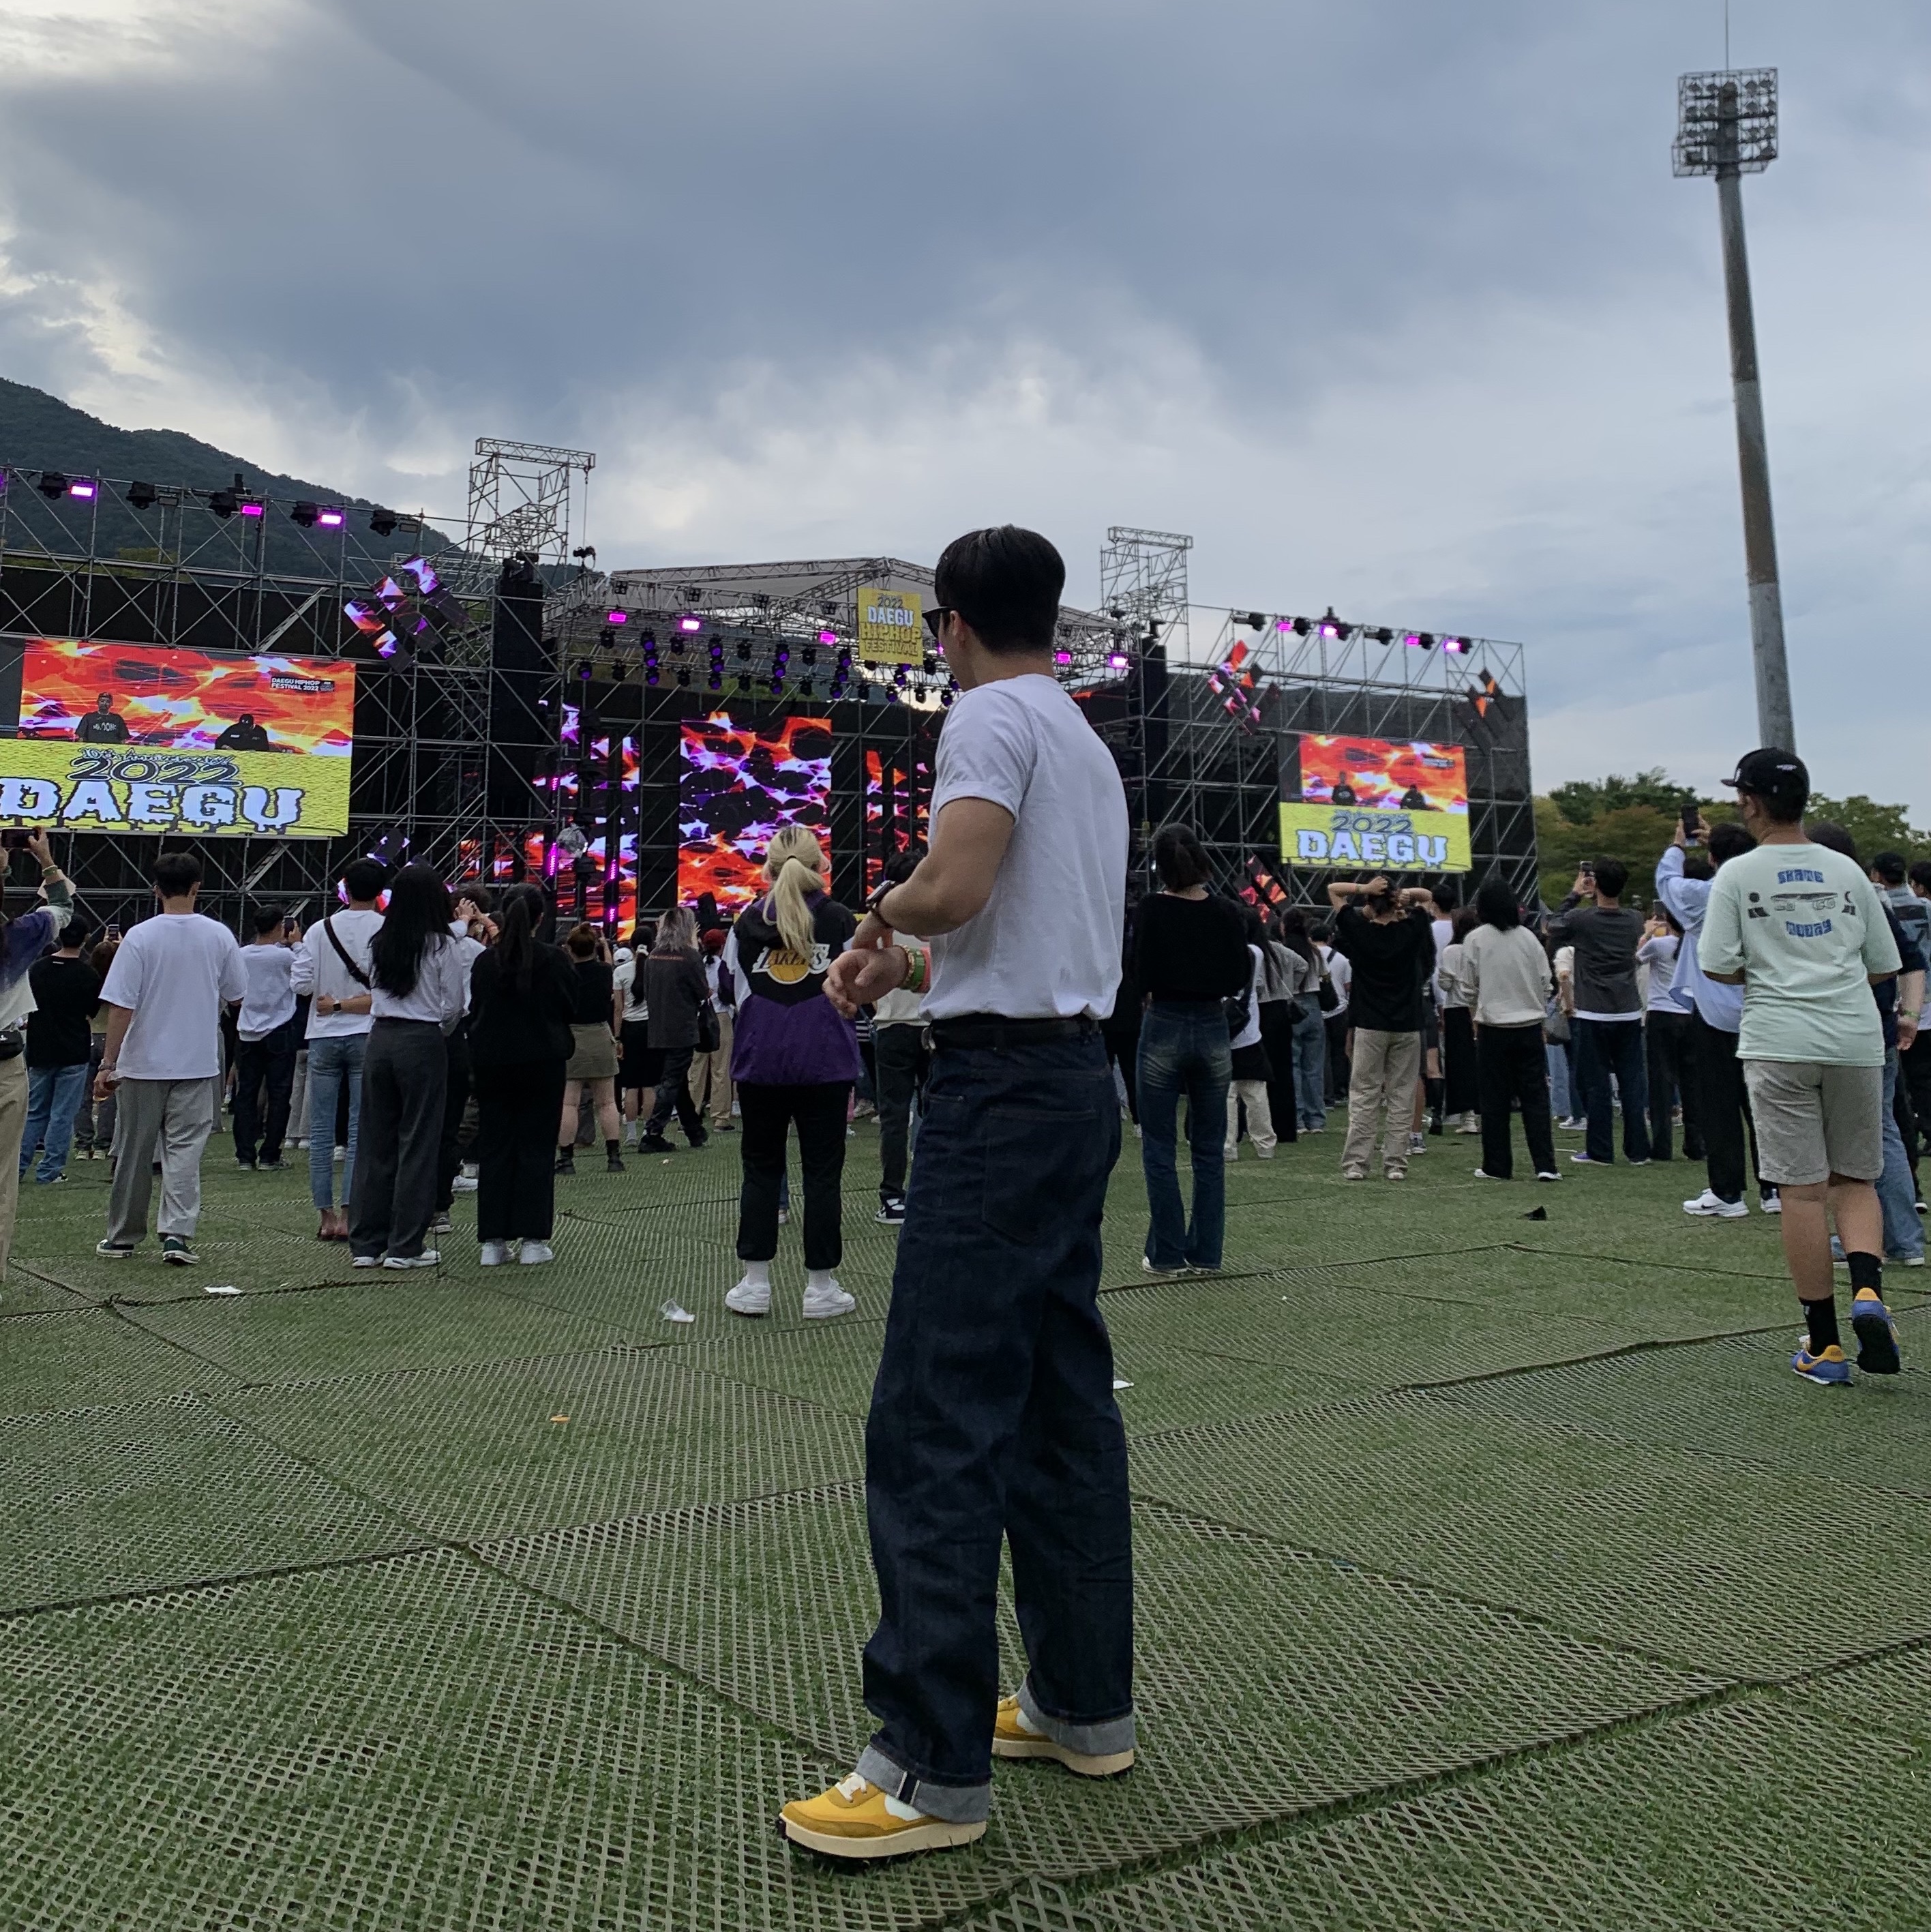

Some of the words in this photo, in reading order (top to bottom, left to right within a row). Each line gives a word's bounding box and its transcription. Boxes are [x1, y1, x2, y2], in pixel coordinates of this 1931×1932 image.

[877, 595, 903, 608] 2022
[867, 606, 914, 627] DAEGU
[859, 622, 922, 644] HIPHOP
[865, 640, 918, 656] FESTIVAL
[66, 756, 243, 787] 2022
[0, 776, 305, 833] DAEGU
[1331, 816, 1413, 833] 2022
[1297, 829, 1448, 868] DAEGU
